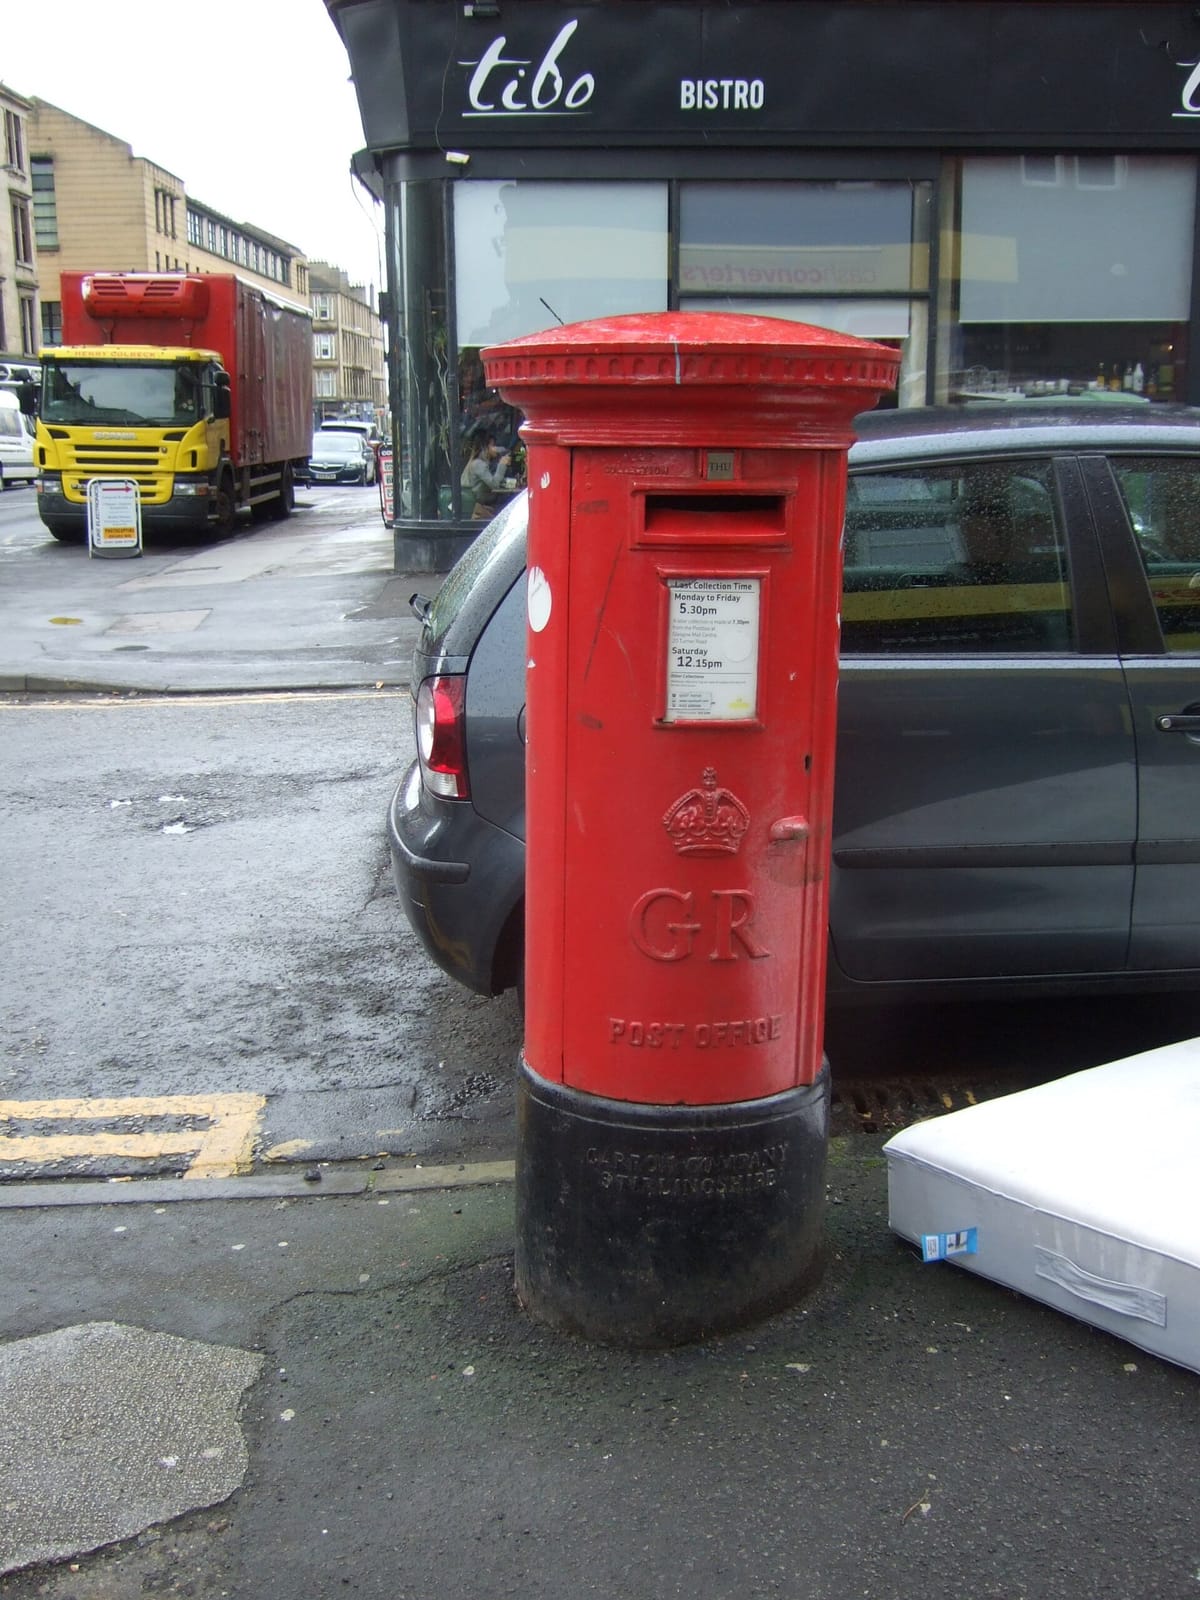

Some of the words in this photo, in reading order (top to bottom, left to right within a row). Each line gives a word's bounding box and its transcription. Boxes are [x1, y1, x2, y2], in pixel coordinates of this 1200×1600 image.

[457, 19, 595, 111] tibo
[680, 80, 765, 110] BISTRO
[93, 431, 137, 440] SCANIA
[674, 581, 692, 589] Last
[693, 581, 732, 590] Collection
[733, 582, 752, 590] Time
[674, 593, 705, 602] Monday
[716, 594, 741, 603] Friday
[679, 602, 717, 616] 5.30pm
[672, 647, 708, 656] Saturday
[677, 656, 722, 669] 12.15pm
[629, 887, 770, 962] GR
[609, 1017, 685, 1049] POST
[695, 1015, 782, 1048] OFFICE
